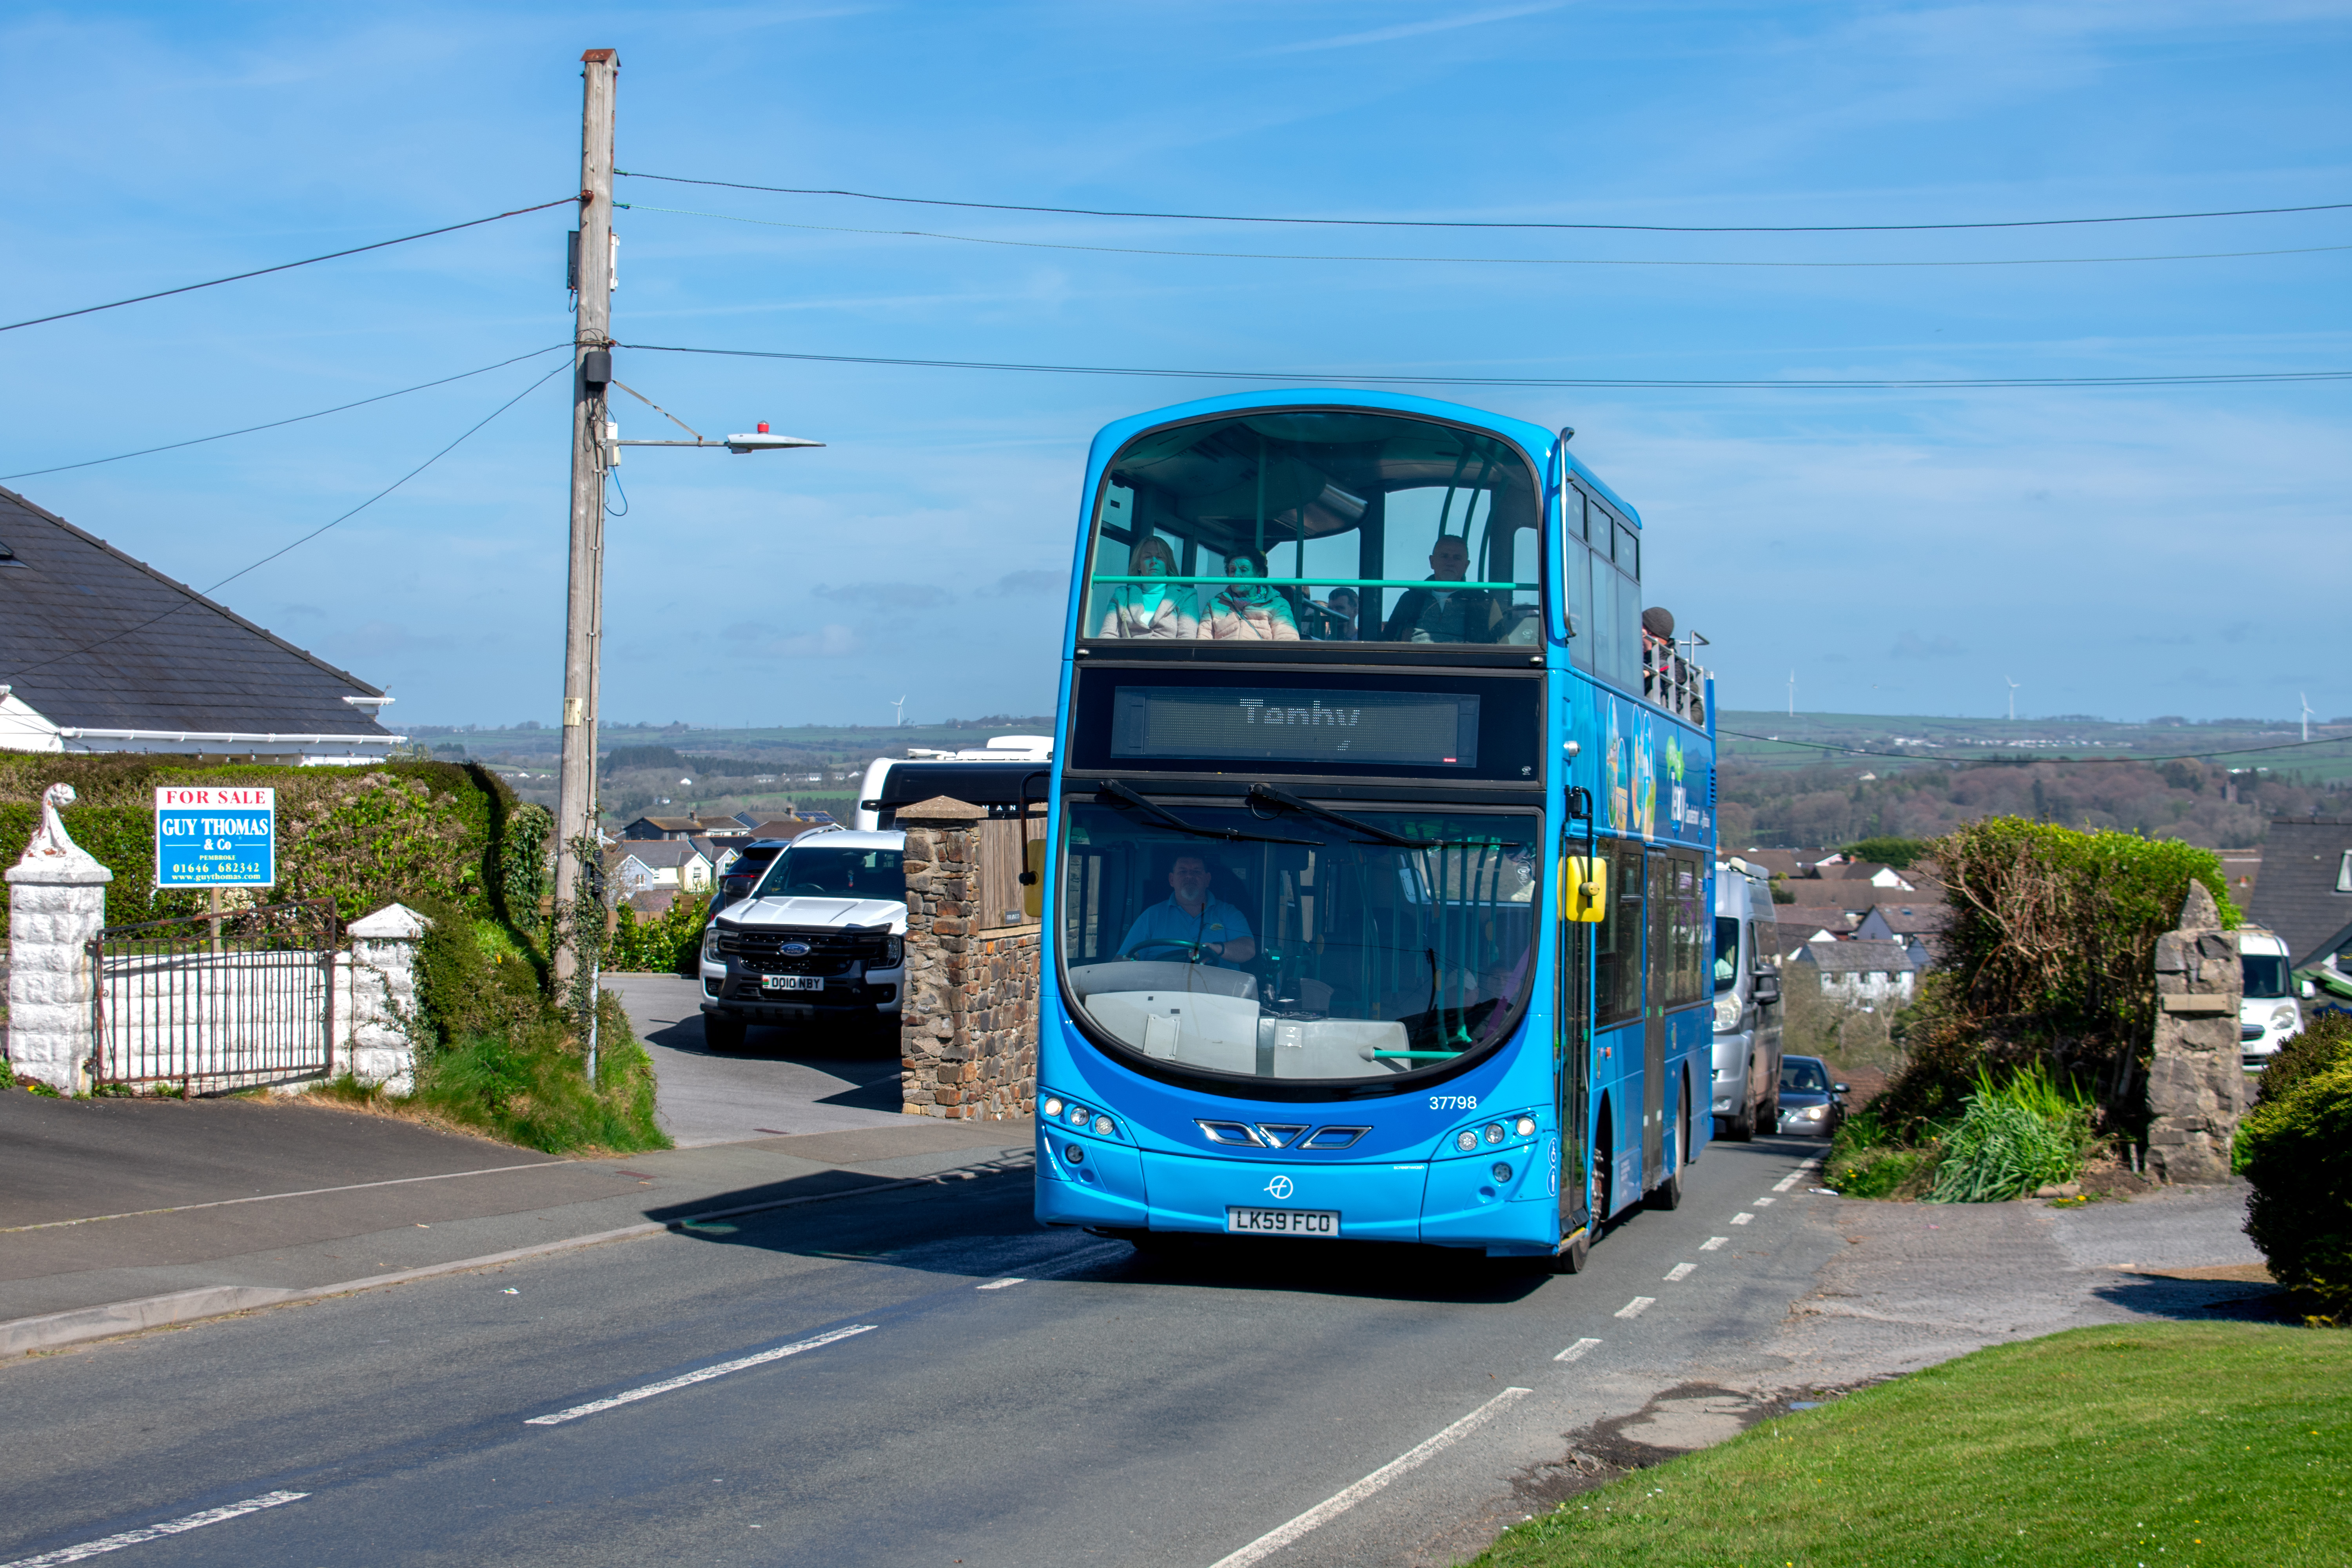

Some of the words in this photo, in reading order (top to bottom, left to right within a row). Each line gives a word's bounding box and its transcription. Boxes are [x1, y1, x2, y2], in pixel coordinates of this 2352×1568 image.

[167, 791, 209, 804] FOR
[218, 791, 265, 804] SALE
[162, 818, 198, 835] GUY
[201, 818, 268, 835] THOMAS
[204, 838, 214, 850] &
[217, 838, 231, 850] Co
[173, 863, 209, 873] 01646
[218, 862, 259, 873] 682342
[172, 873, 261, 882] www.guythomas.com
[799, 978, 820, 989] NBY
[1430, 1096, 1477, 1110] 37798
[1237, 1210, 1287, 1230] LK59
